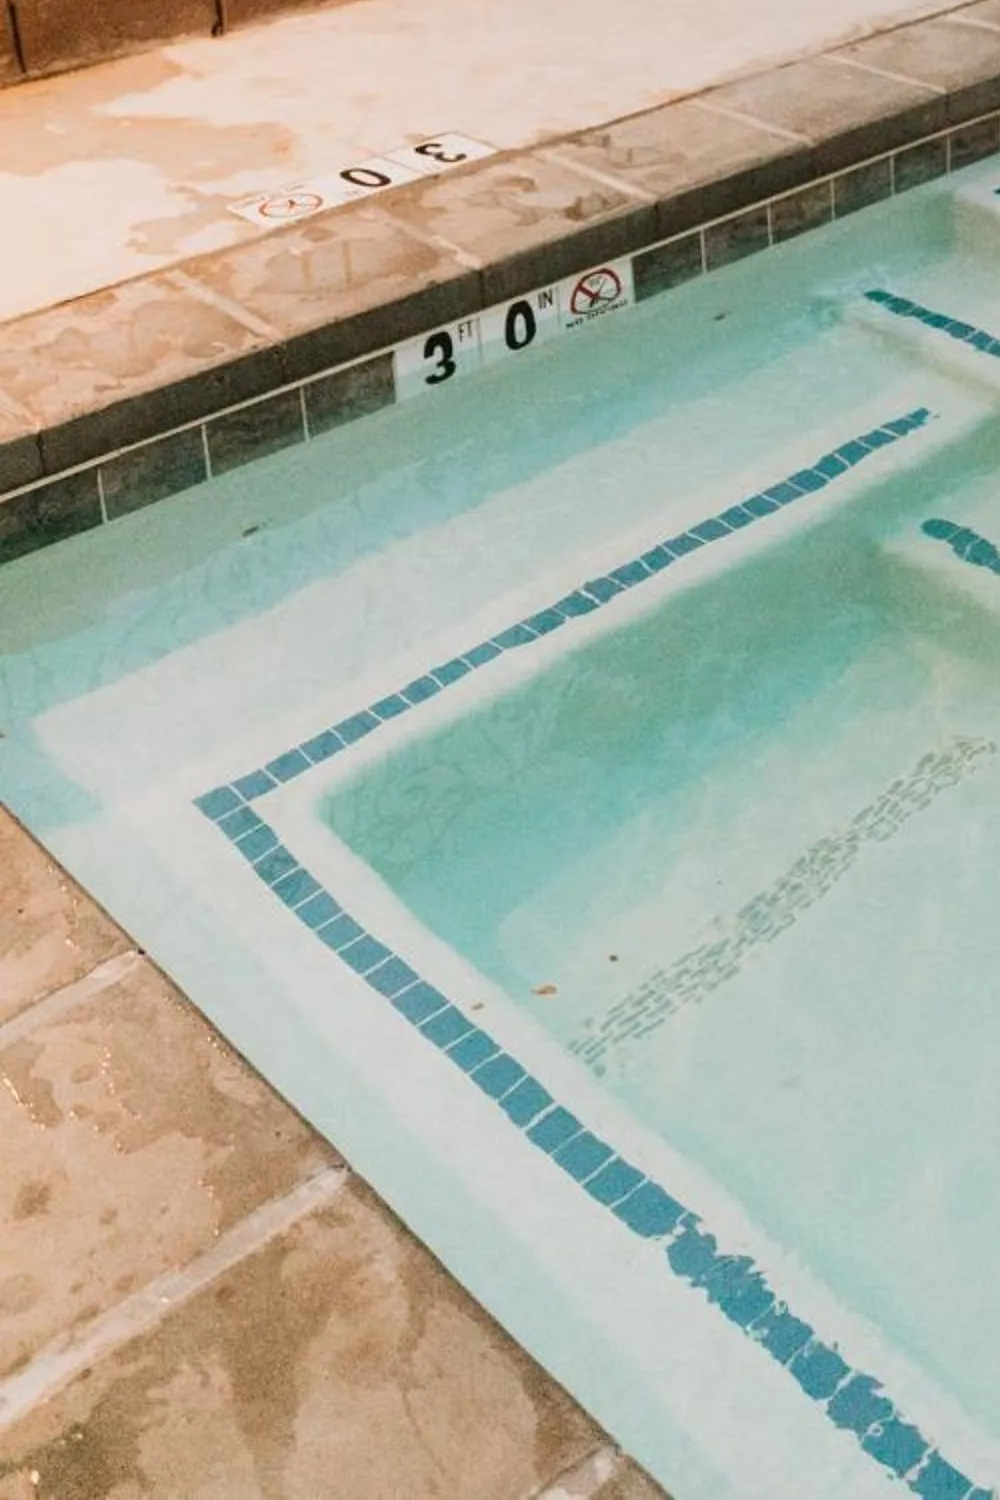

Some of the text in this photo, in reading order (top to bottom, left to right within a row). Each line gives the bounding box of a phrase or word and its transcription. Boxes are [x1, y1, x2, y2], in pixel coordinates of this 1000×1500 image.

[340, 143, 467, 188] 3 0
[423, 330, 457, 385] 3
[457, 321, 474, 342] FT
[504, 299, 537, 351] 0
[537, 289, 554, 311] IN
